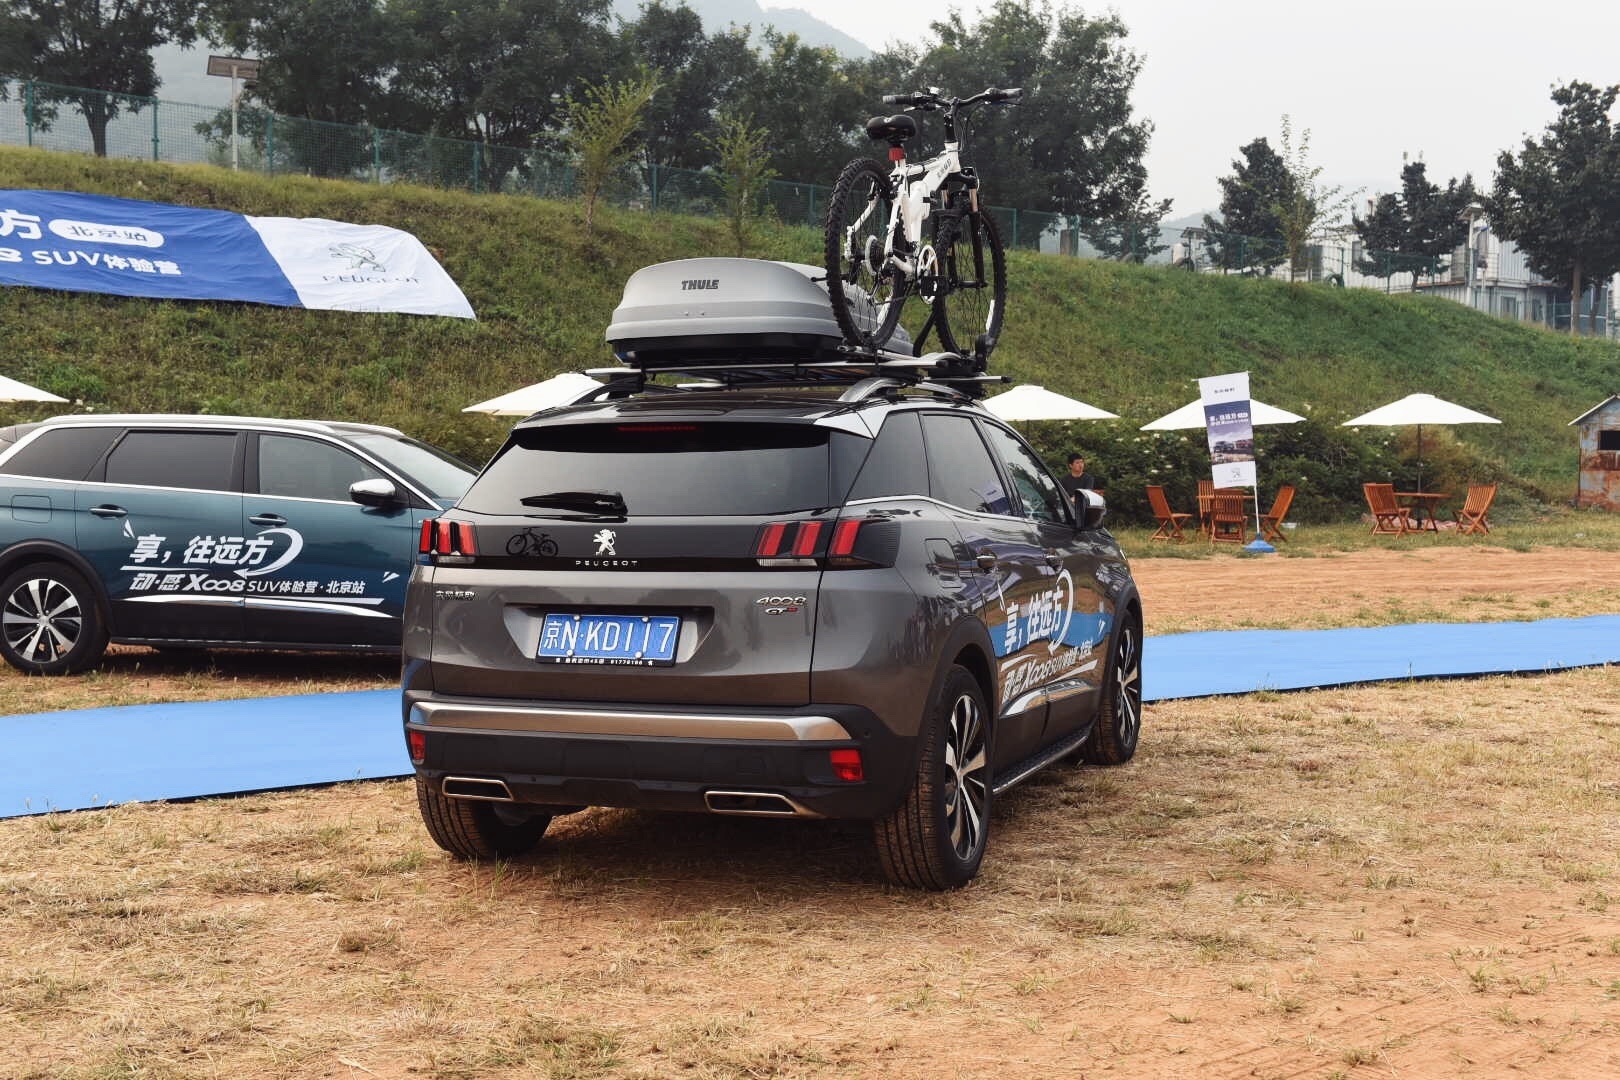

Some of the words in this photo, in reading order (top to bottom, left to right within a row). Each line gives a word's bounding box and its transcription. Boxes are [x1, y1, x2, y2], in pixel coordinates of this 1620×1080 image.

[0, 209, 43, 240] 方
[681, 279, 720, 290] THULE
[756, 596, 807, 606] 4008
